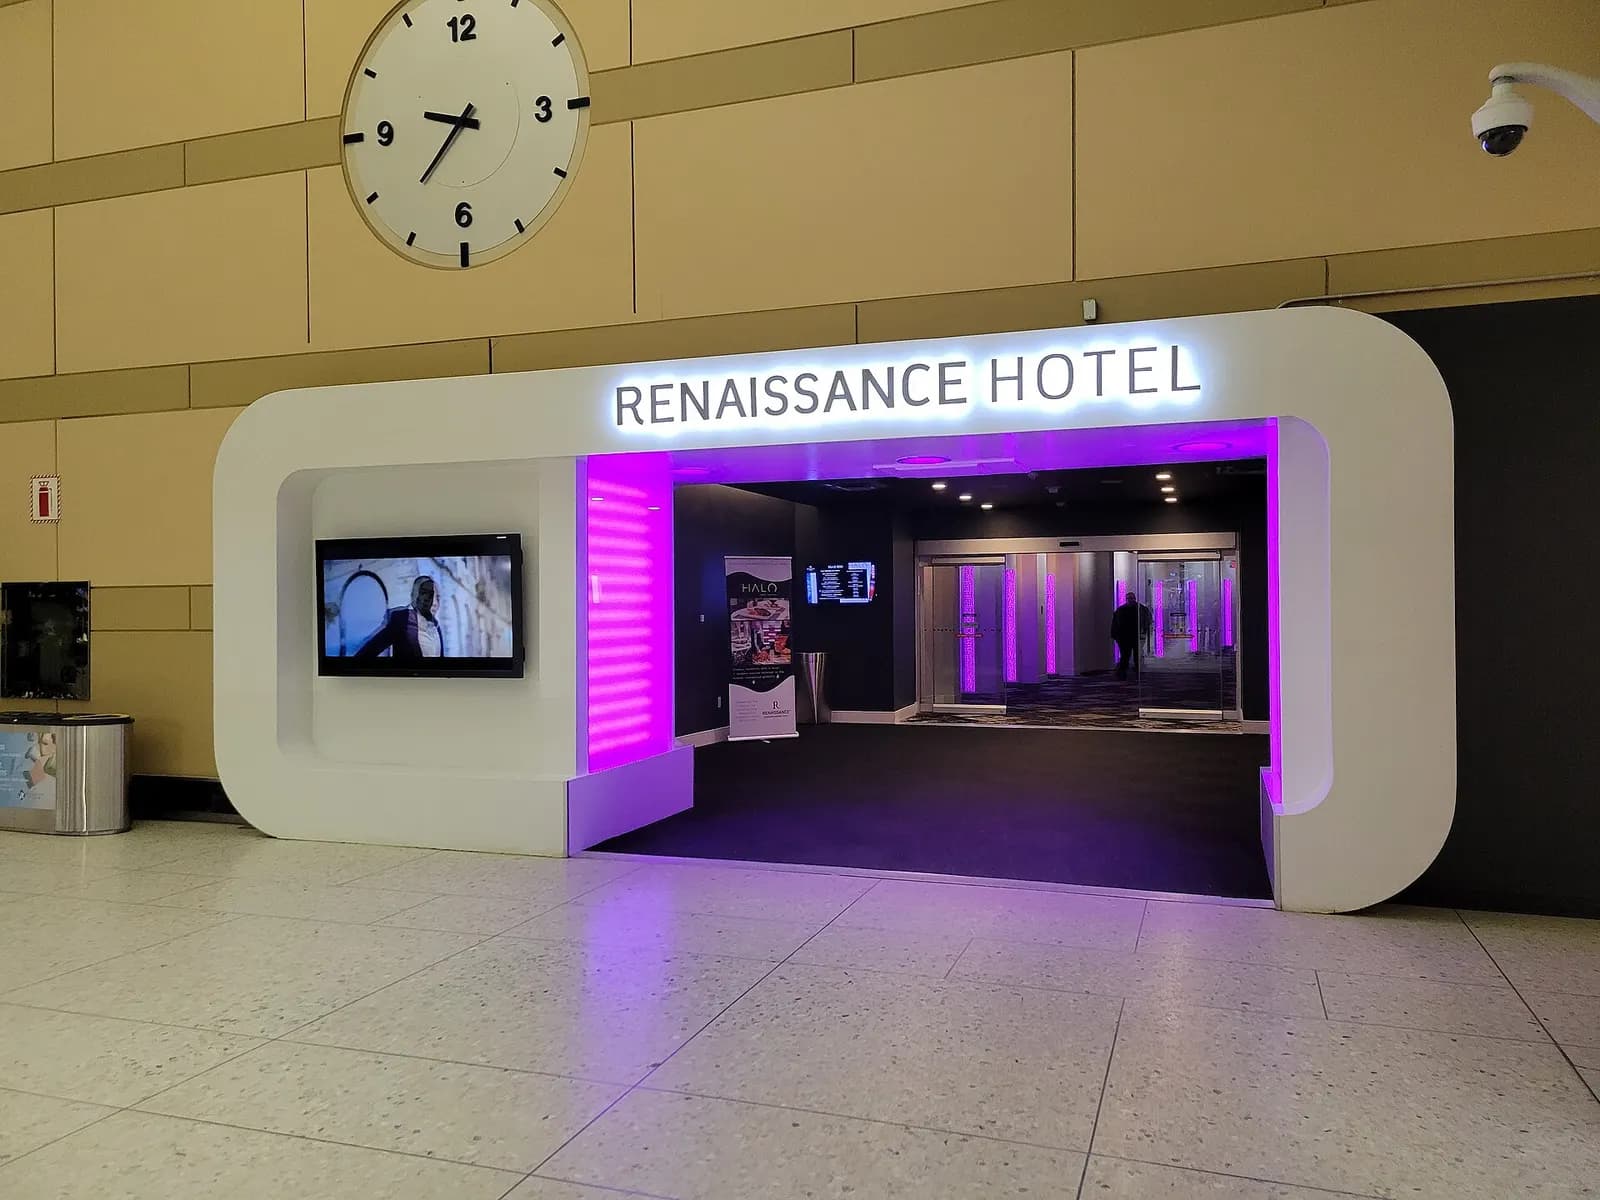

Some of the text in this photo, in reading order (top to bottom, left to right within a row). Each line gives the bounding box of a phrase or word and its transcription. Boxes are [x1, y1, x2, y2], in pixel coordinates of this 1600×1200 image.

[446, 14, 477, 42] 12
[534, 96, 553, 122] 3
[377, 121, 394, 146] 9
[454, 202, 473, 228] 6
[616, 345, 1201, 426] RENAISSANCE HOTEL
[742, 583, 778, 593] HALO
